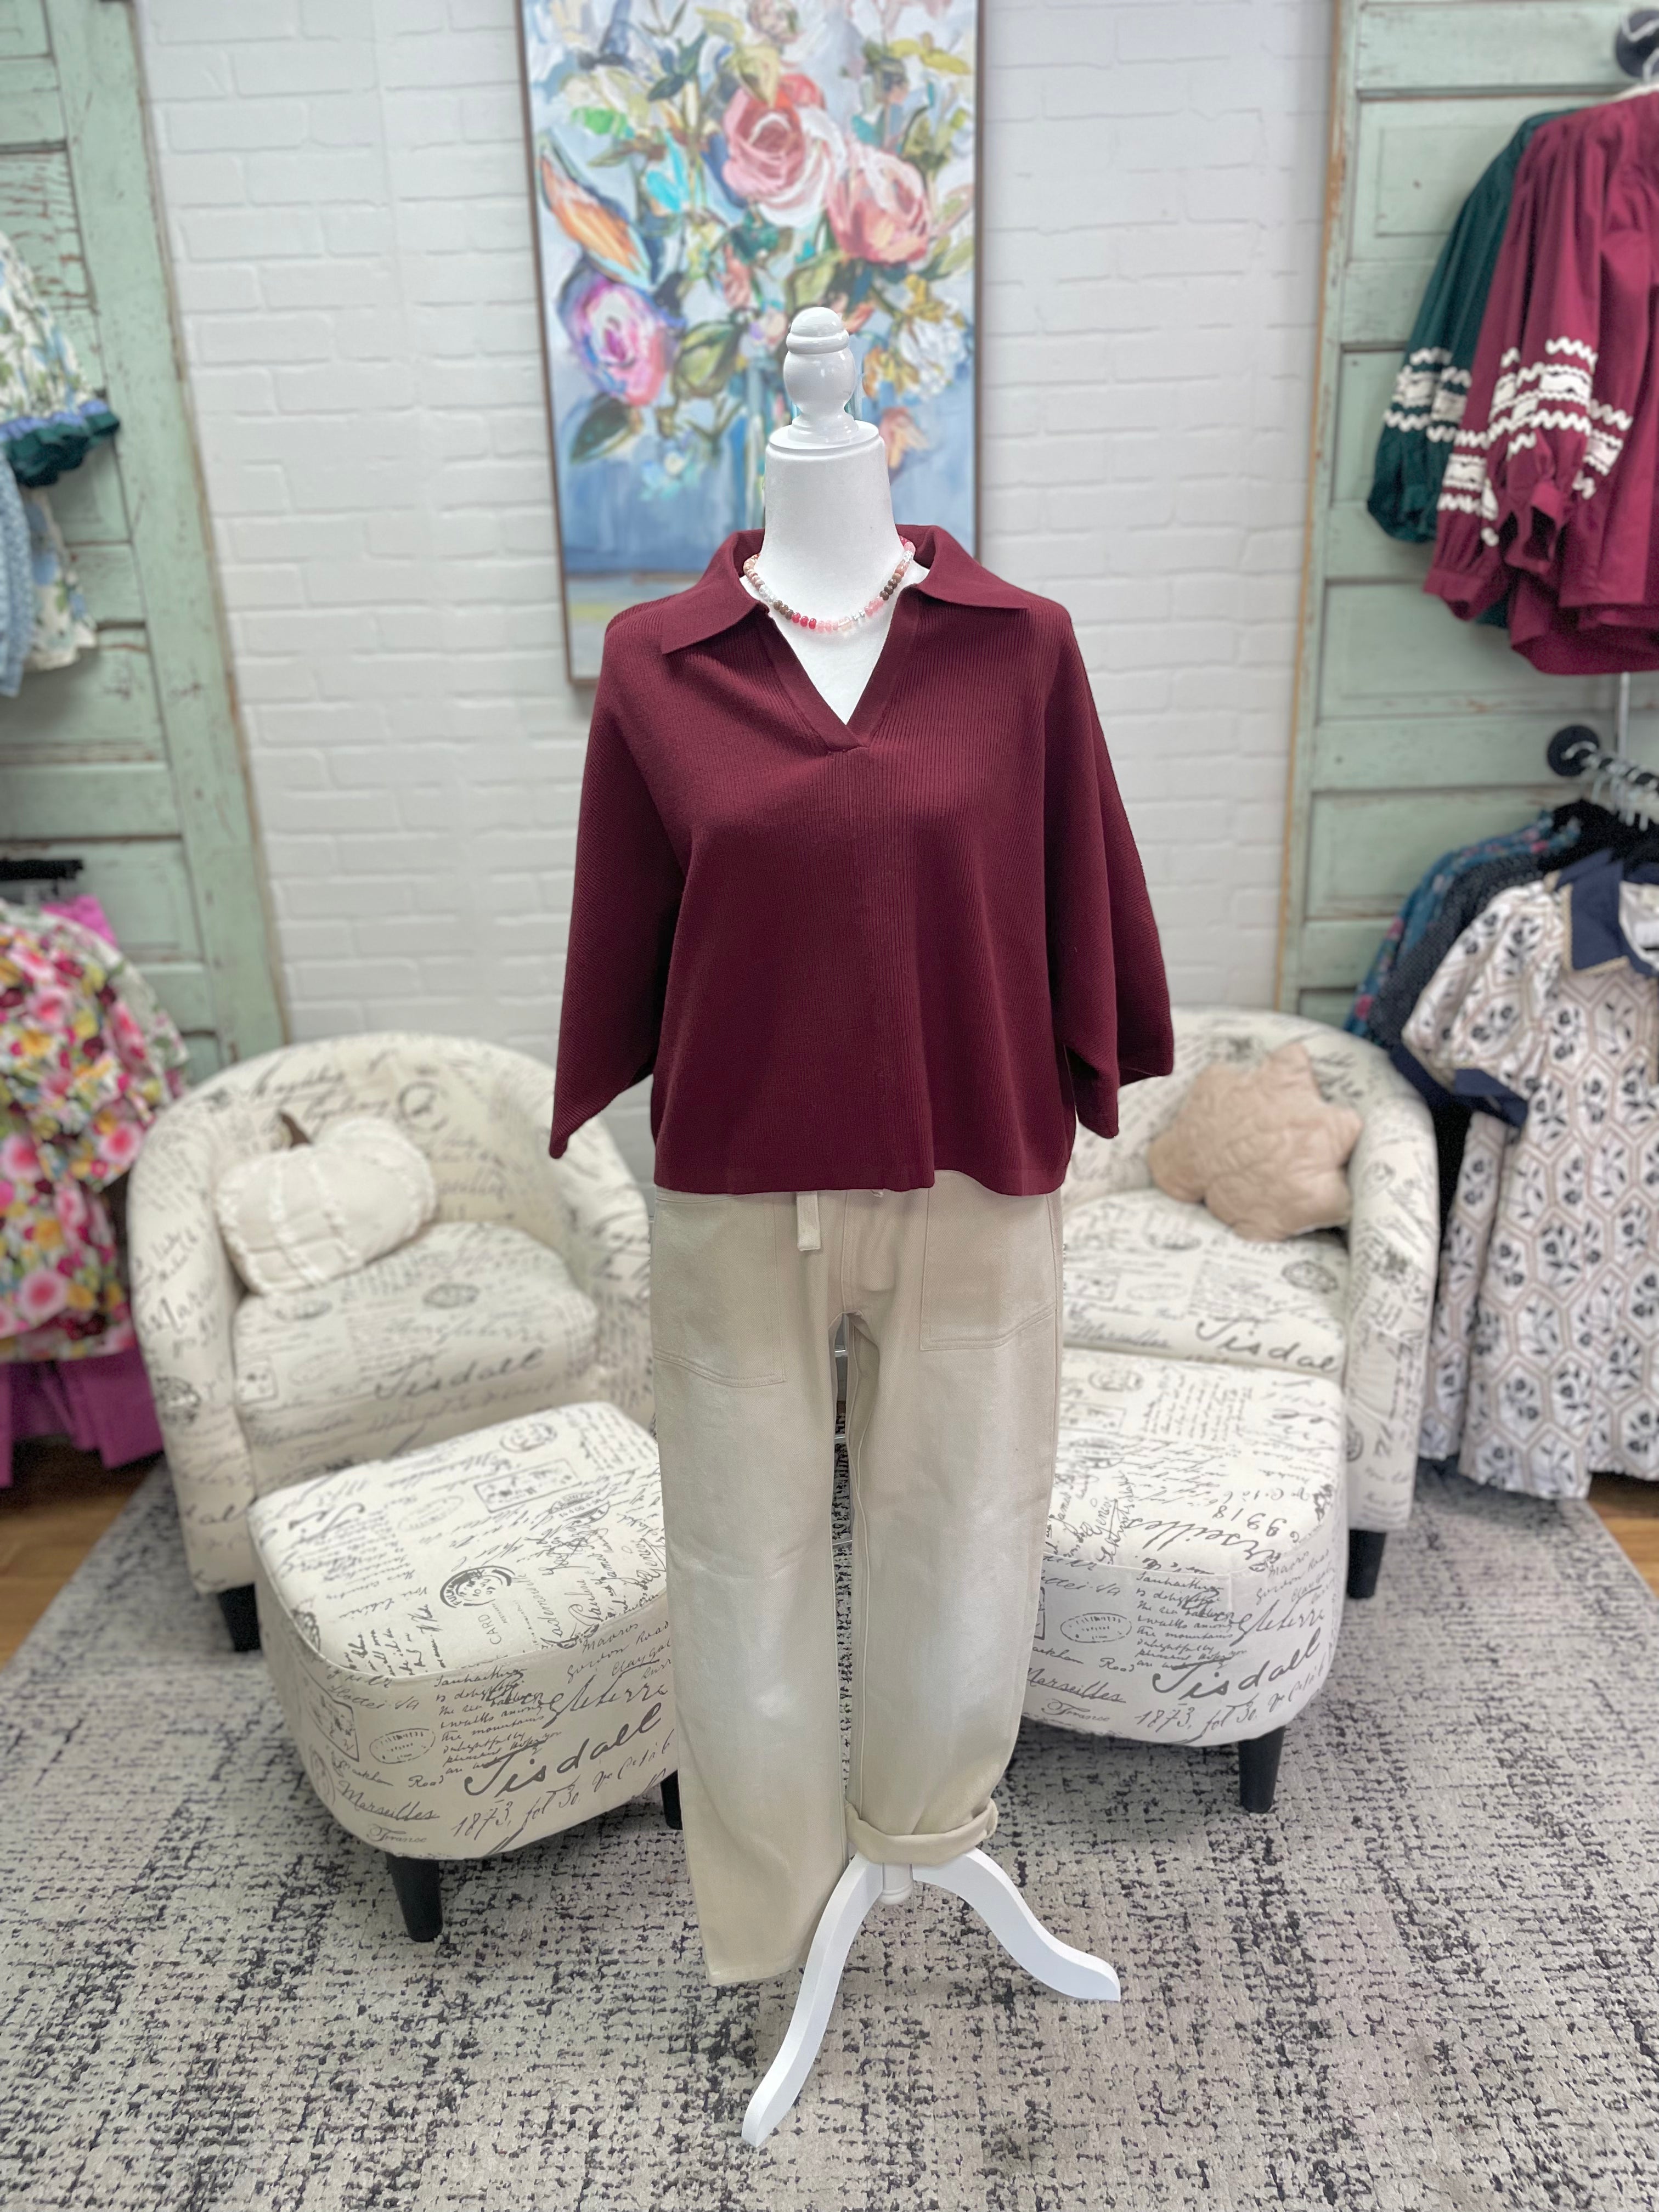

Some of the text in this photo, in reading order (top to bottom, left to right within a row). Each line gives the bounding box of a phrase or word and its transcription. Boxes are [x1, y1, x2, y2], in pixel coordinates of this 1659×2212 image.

[478, 1614, 502, 1645] CARD
[1152, 1626, 1321, 1701] Tisdall
[464, 1701, 662, 1798] Tisdall
[335, 1780, 441, 1822] Marseilles
